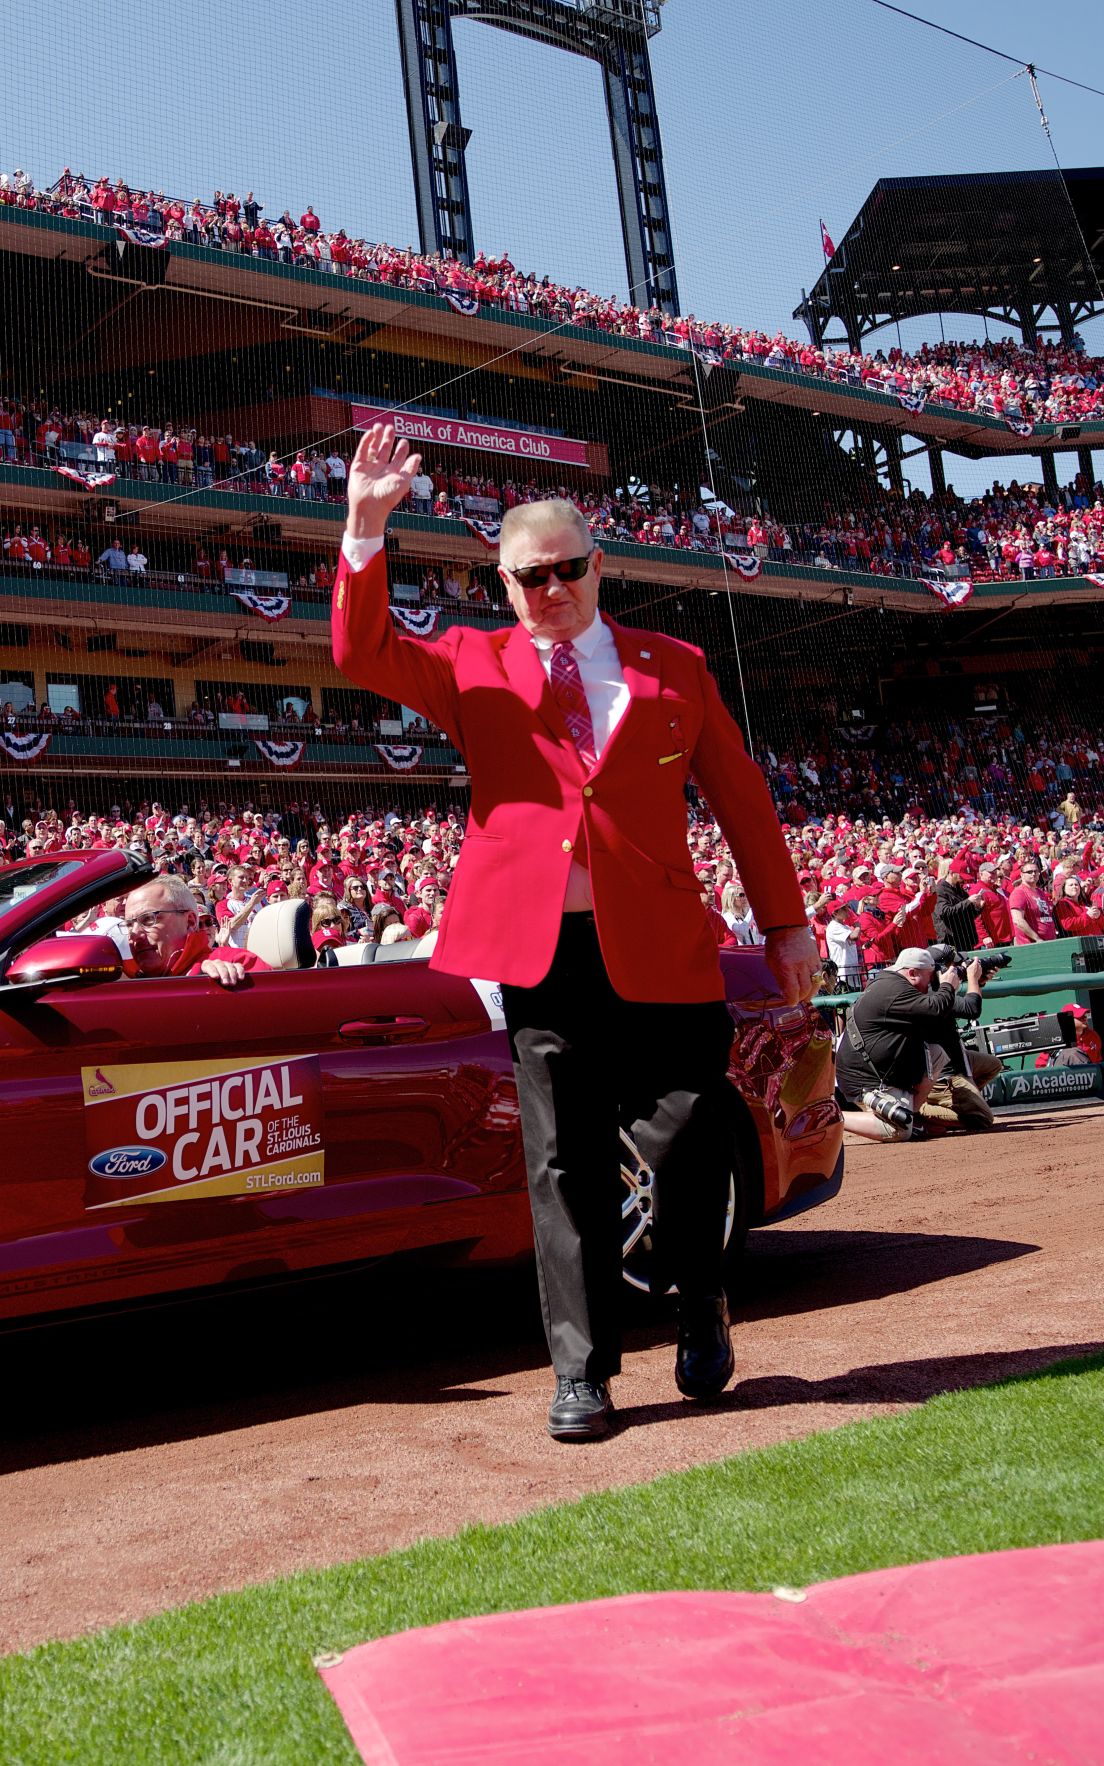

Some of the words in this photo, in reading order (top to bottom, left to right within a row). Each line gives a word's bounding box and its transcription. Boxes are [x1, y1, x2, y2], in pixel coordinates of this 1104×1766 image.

[394, 415, 434, 438] Bank
[437, 424, 452, 440] of
[457, 426, 516, 451] America
[519, 437, 551, 457] Club
[32, 561, 42, 569] 60
[7, 716, 16, 724] 27
[1032, 1071, 1095, 1088] Academy
[136, 1065, 303, 1139] OFFICIAL
[267, 1120, 280, 1132] OF
[281, 1115, 300, 1129] THE
[266, 1133, 321, 1156] CARDINALS
[267, 1132, 282, 1145] ST.
[283, 1124, 311, 1140] LOUIS
[172, 1118, 263, 1181] CAR
[105, 1151, 153, 1174] Ford
[246, 1171, 321, 1189] STLFord.com
